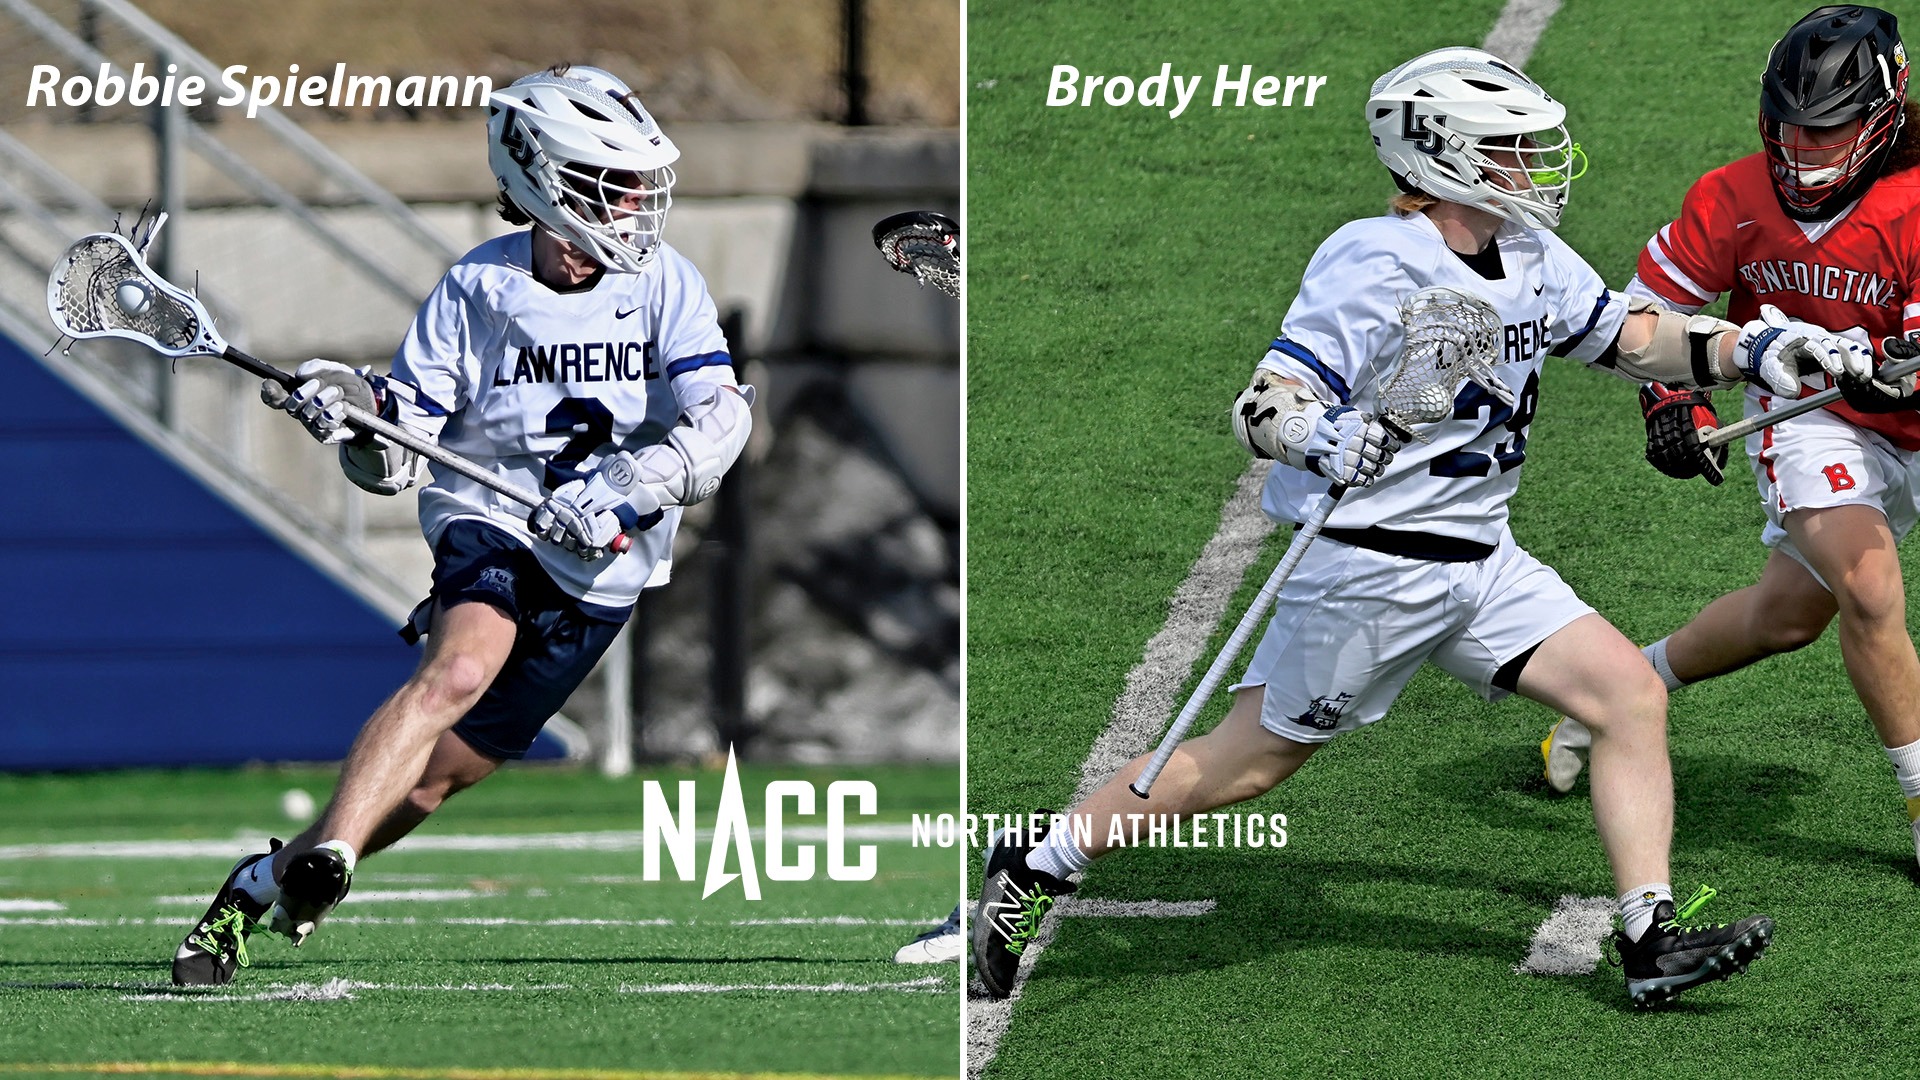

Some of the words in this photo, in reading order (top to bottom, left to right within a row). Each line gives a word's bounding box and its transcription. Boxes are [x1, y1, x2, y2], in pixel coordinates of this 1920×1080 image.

[1738, 258, 1899, 309] BENEDICTINE
[494, 339, 660, 387] LAWRENCE
[543, 396, 615, 492] 2
[1429, 368, 1540, 478] 29
[1820, 462, 1857, 494] B
